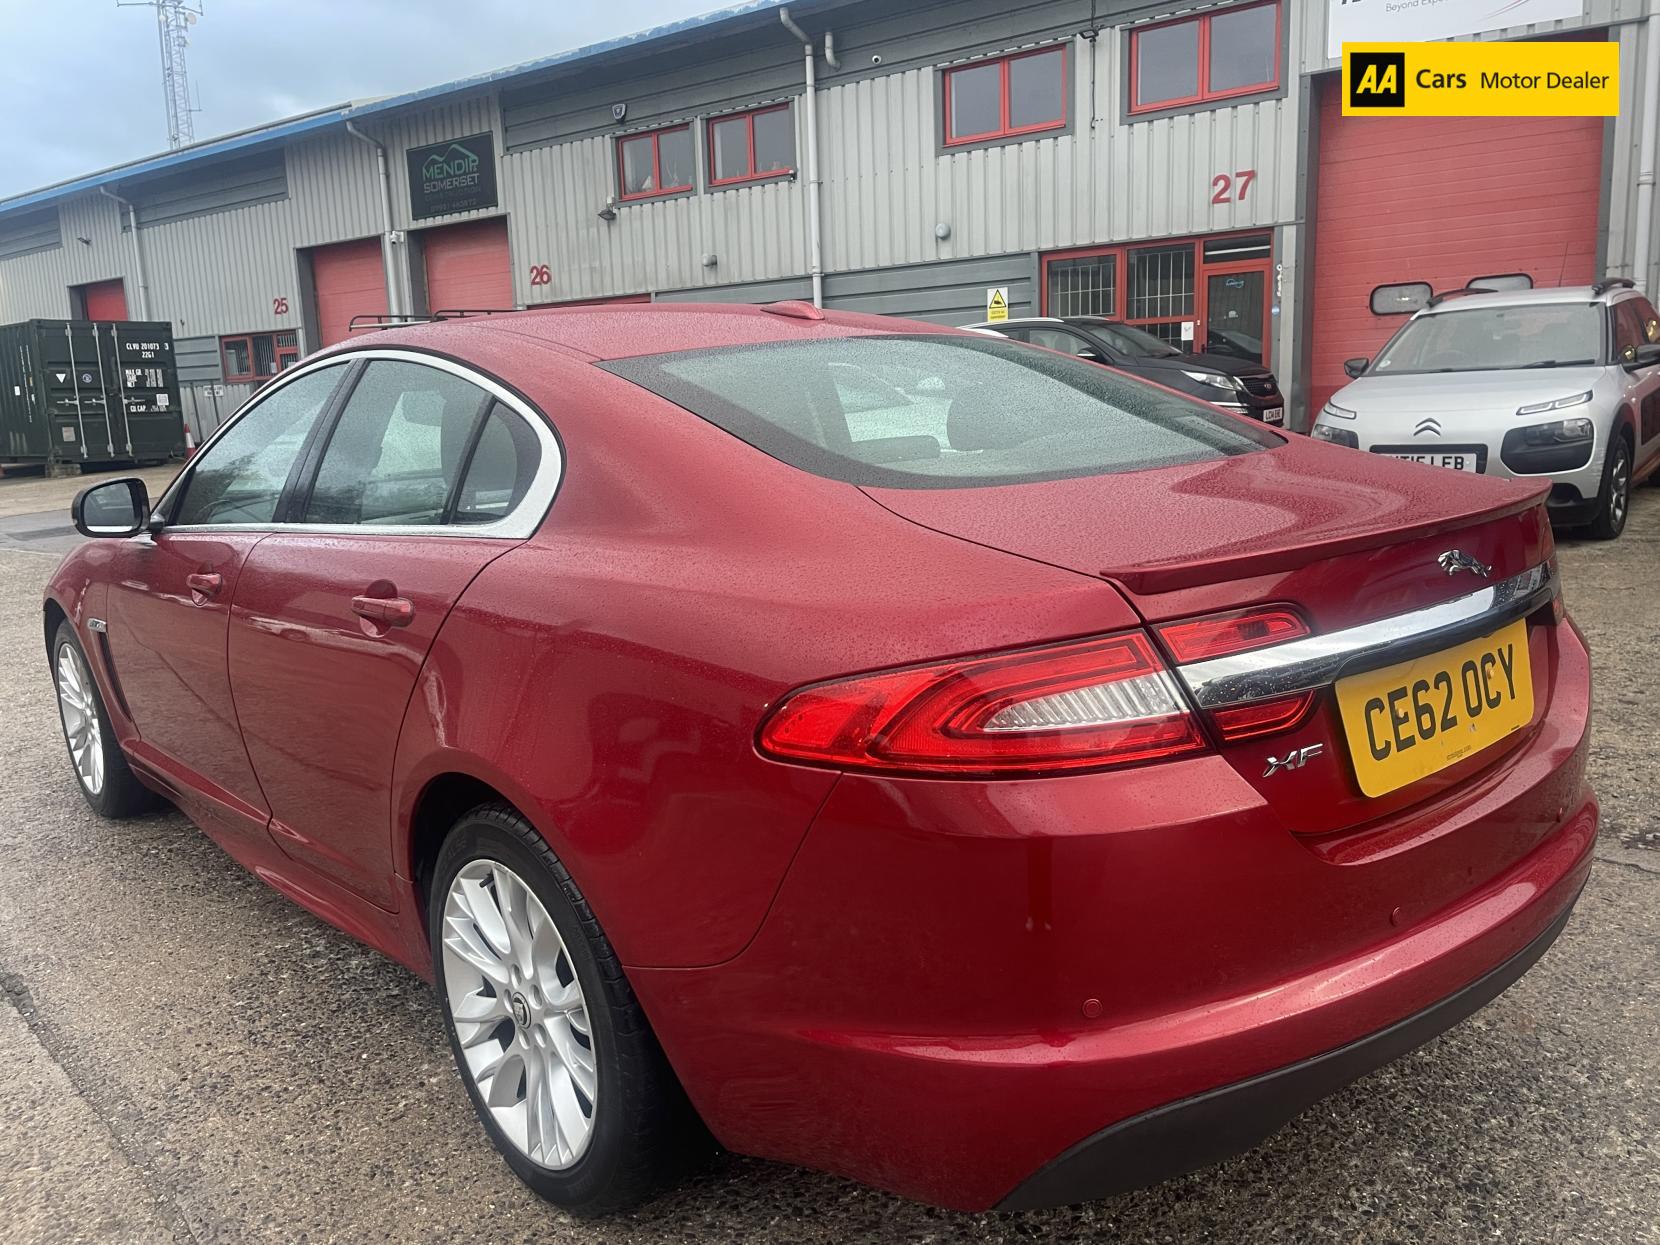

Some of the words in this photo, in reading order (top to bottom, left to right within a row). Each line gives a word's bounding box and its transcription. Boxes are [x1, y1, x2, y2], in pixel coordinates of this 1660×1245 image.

[1385, 1, 1419, 12] Beyond
[422, 157, 479, 181] MENDIP
[424, 173, 480, 194] SOMERSET
[1211, 169, 1256, 204] 27
[529, 264, 551, 286] 26
[273, 297, 289, 315] 25
[1364, 671, 1458, 761] CE62
[1461, 644, 1516, 718] OCY
[1262, 743, 1323, 778] XF
